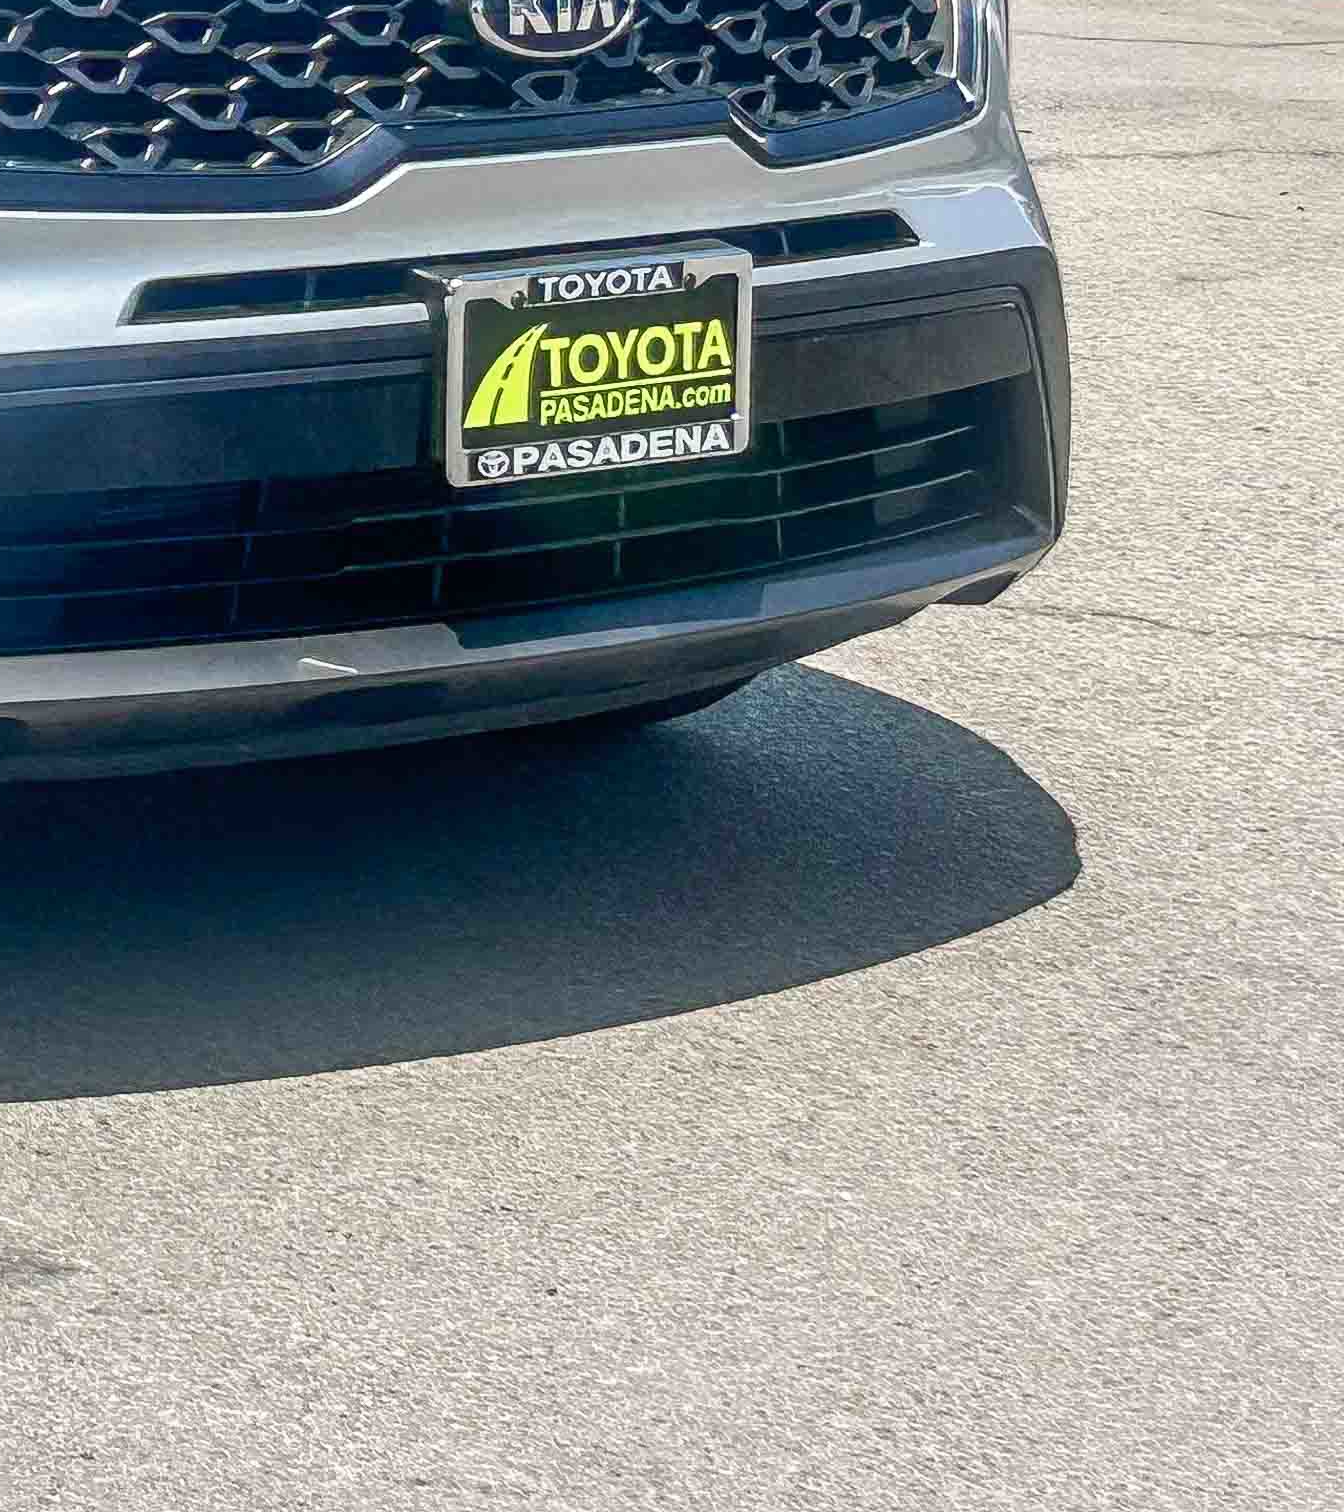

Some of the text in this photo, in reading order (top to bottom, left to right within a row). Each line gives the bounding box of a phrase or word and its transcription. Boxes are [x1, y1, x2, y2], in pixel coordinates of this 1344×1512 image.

[538, 265, 674, 302] TOYOTA
[540, 317, 732, 388] TOYOTA
[539, 382, 732, 426] PASADENA.com
[513, 423, 730, 475] PASADENA
